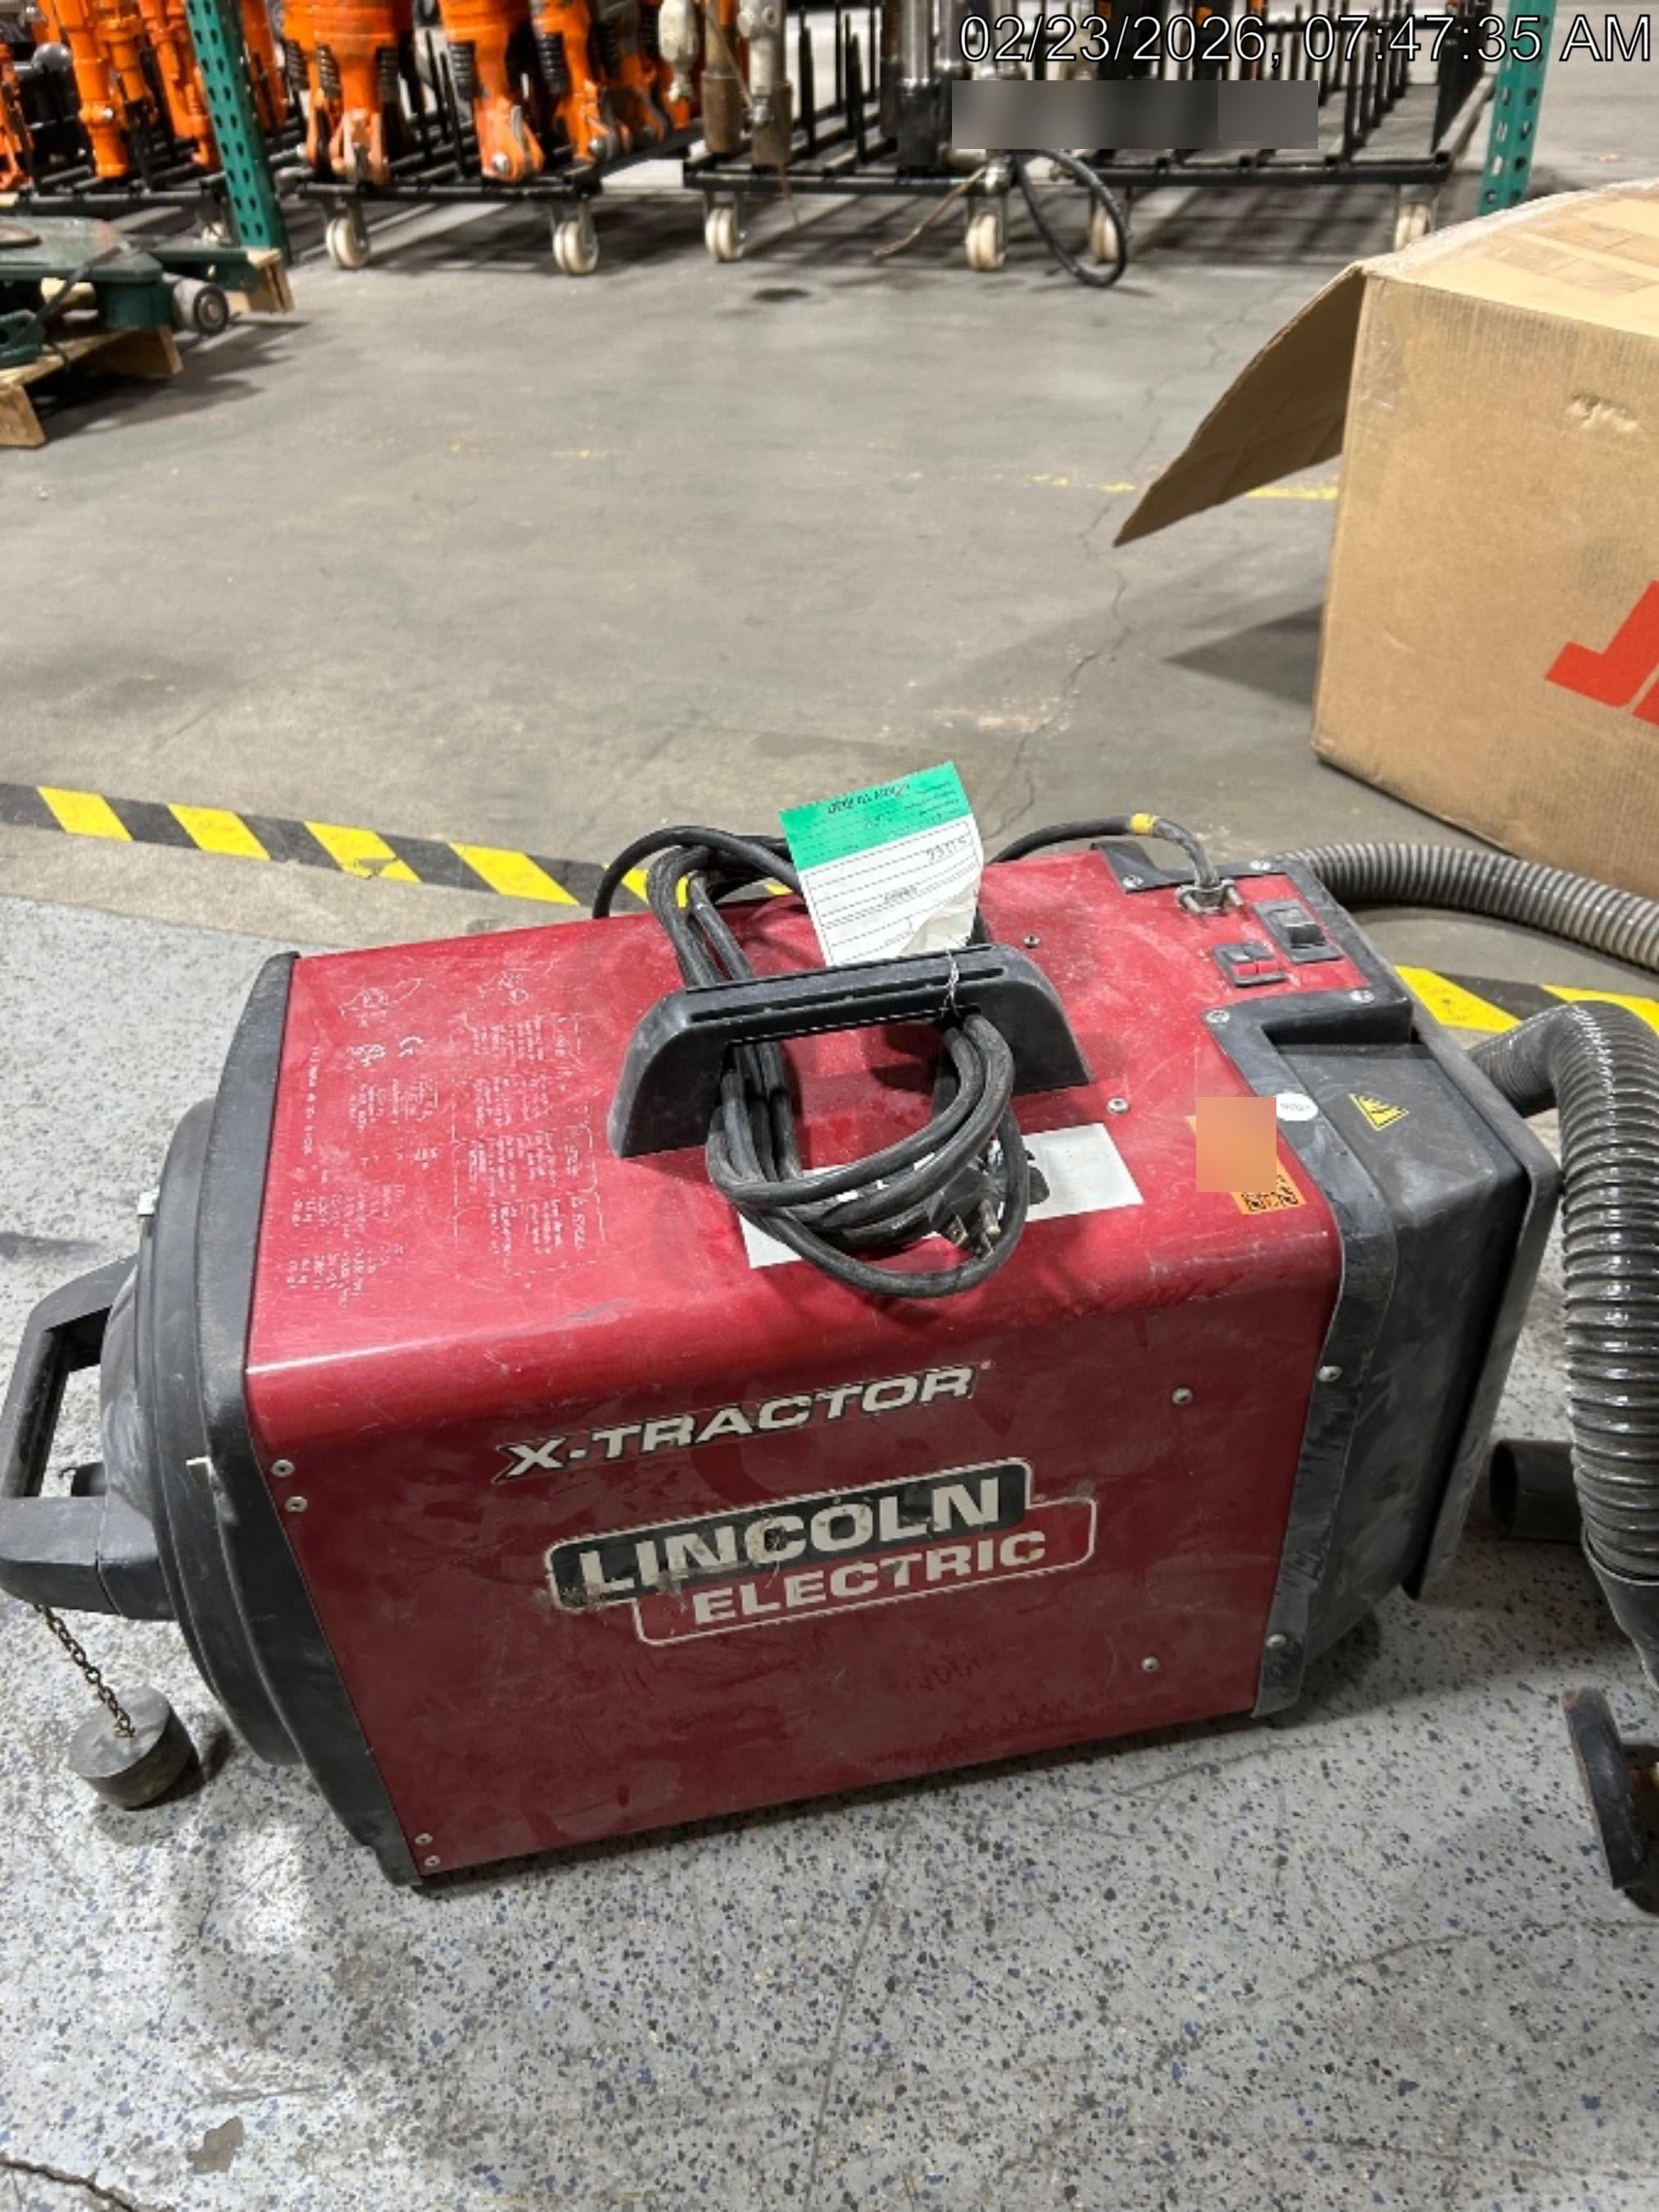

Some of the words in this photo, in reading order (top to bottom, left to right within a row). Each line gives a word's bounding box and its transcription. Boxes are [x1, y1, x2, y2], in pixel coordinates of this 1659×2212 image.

[495, 1366, 978, 1480] X-TRACTOR
[578, 1477, 999, 1593] LINCOLN
[693, 1530, 1046, 1625] ELECTRIC
